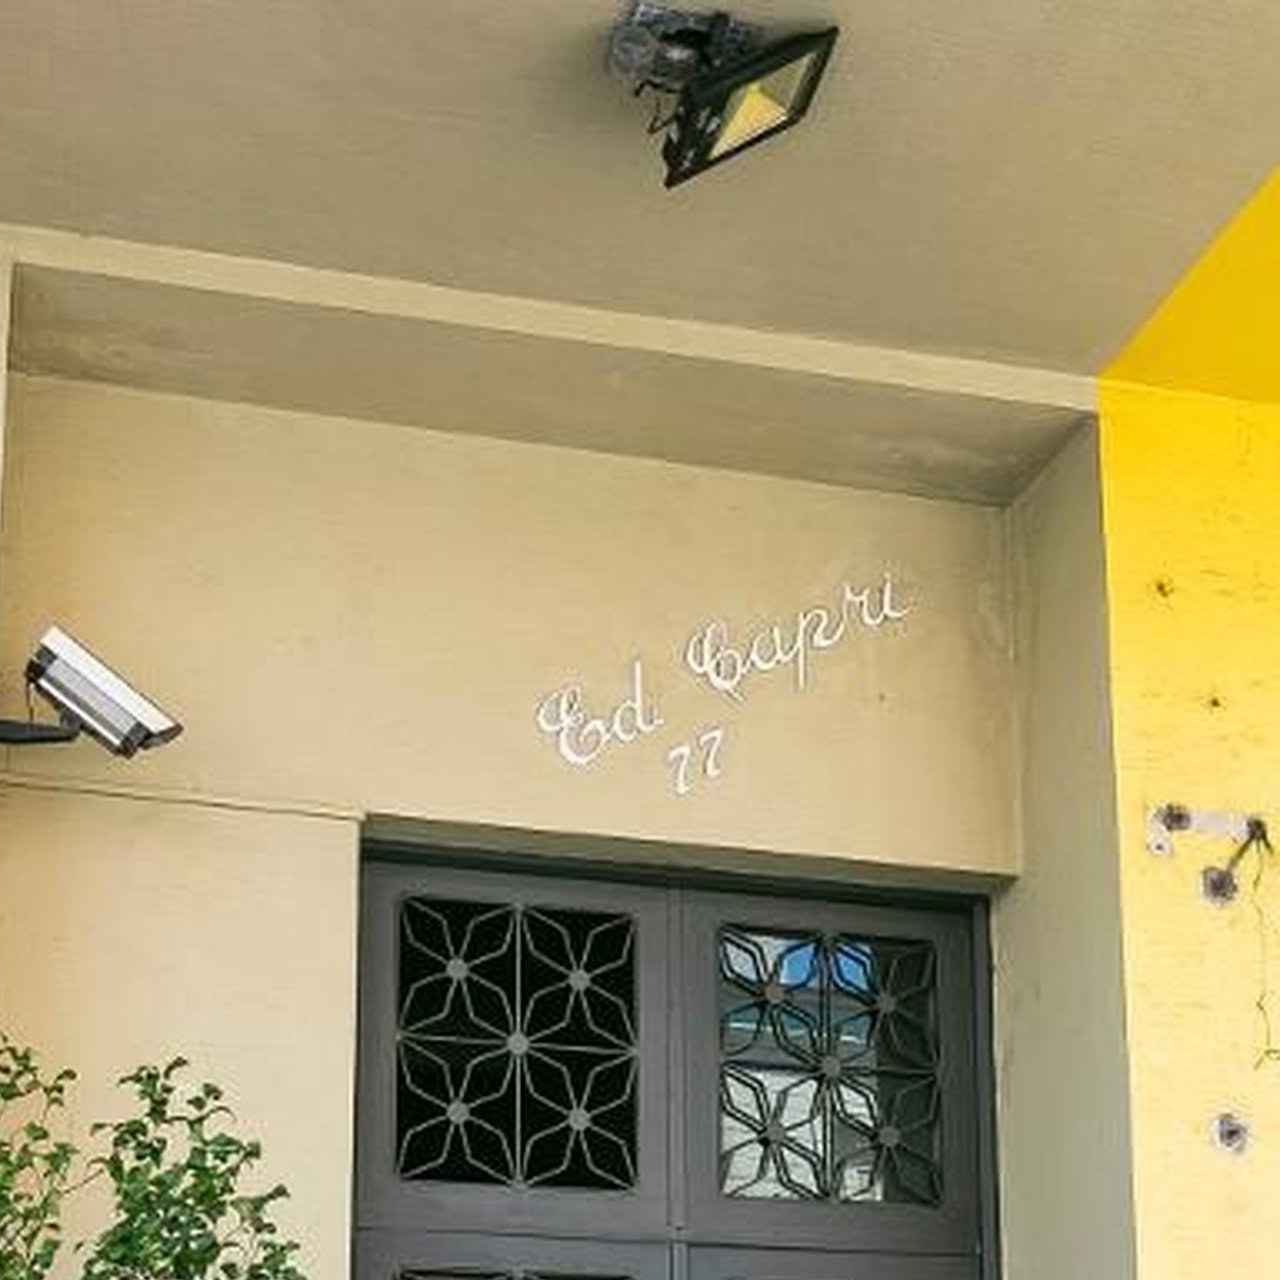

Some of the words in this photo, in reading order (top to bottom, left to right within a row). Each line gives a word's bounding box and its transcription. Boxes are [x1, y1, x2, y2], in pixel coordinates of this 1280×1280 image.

[536, 660, 664, 766] Ed
[685, 571, 910, 702] Capri
[668, 729, 724, 794] 77
